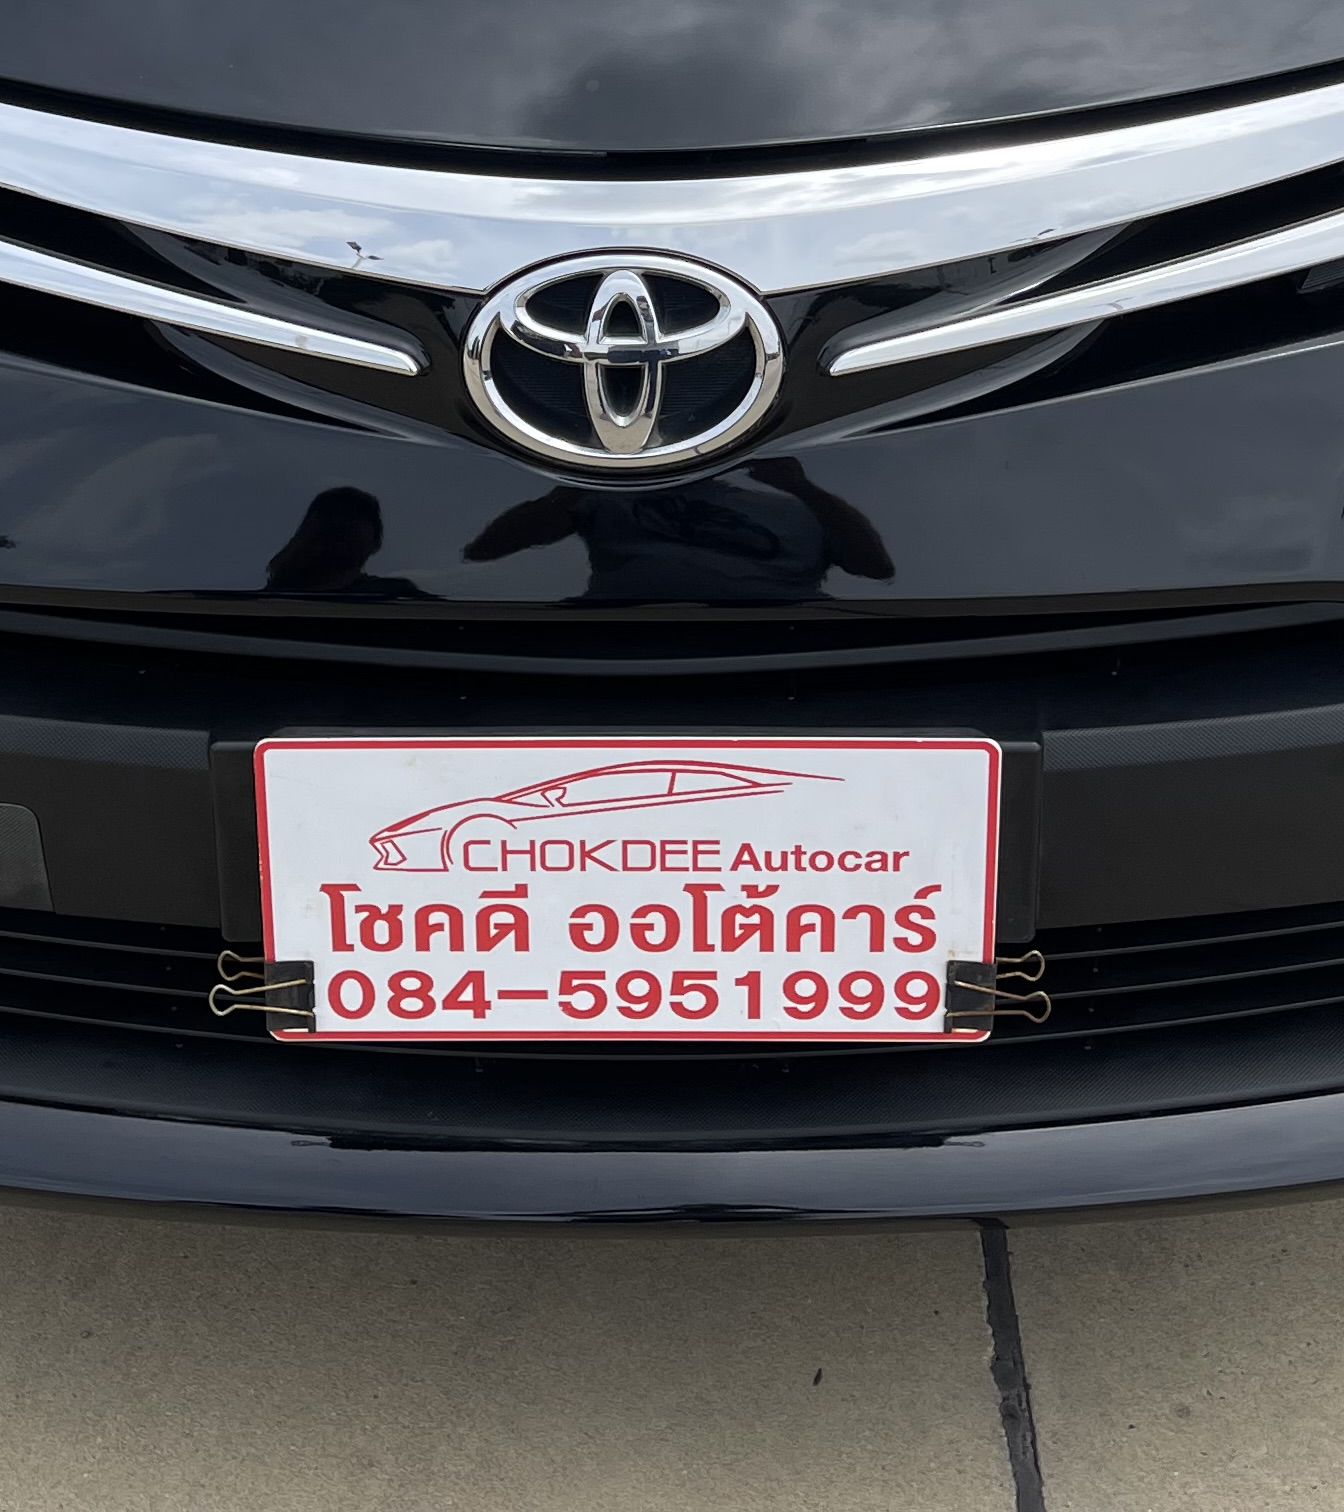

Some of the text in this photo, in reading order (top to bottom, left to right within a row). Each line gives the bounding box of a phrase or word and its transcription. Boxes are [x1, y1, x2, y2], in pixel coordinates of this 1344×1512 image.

[463, 839, 910, 874] CHOKDEE Autocar
[320, 883, 942, 953] โชคดี ออโต้คาร์
[327, 969, 941, 1021] 084-5951999
